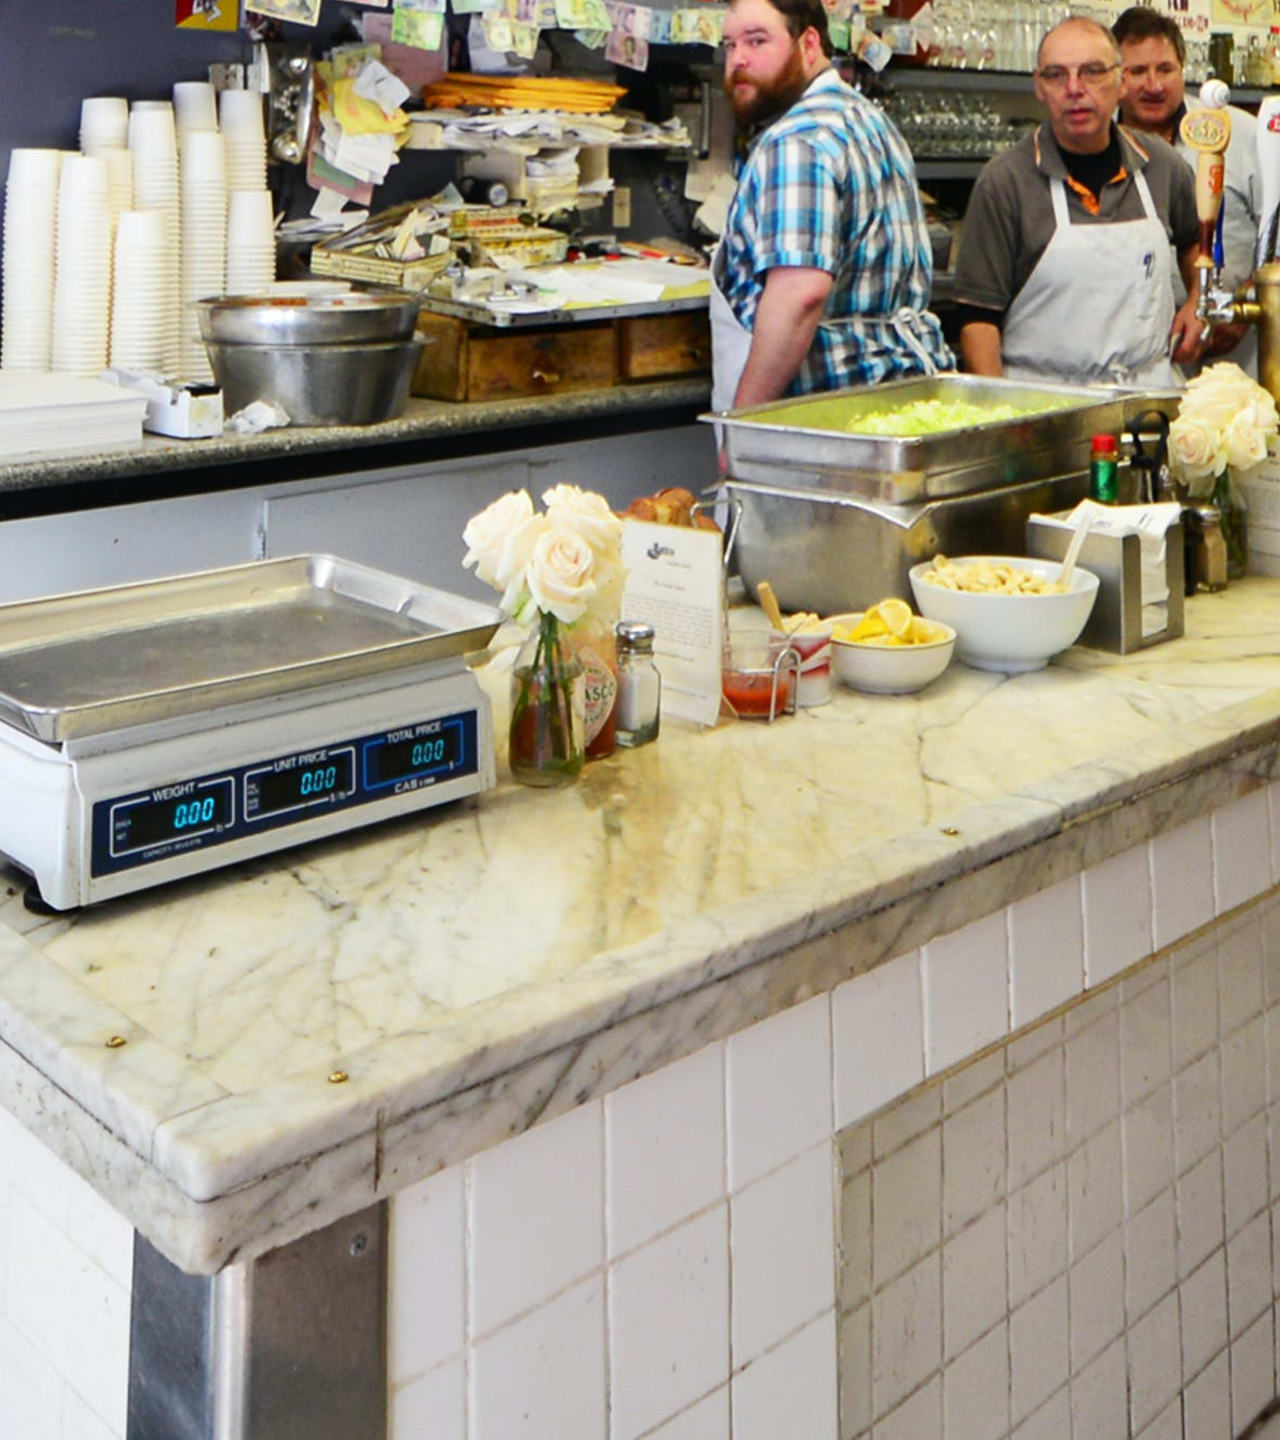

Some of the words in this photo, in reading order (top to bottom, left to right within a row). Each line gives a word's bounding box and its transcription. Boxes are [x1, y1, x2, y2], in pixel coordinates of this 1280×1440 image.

[386, 728, 414, 744] TOTAL
[415, 721, 442, 737] PRICE
[273, 756, 298, 773] UNIT
[298, 748, 328, 766] PRICE
[151, 780, 197, 803] WEIGHT
[394, 778, 418, 793] CAS
